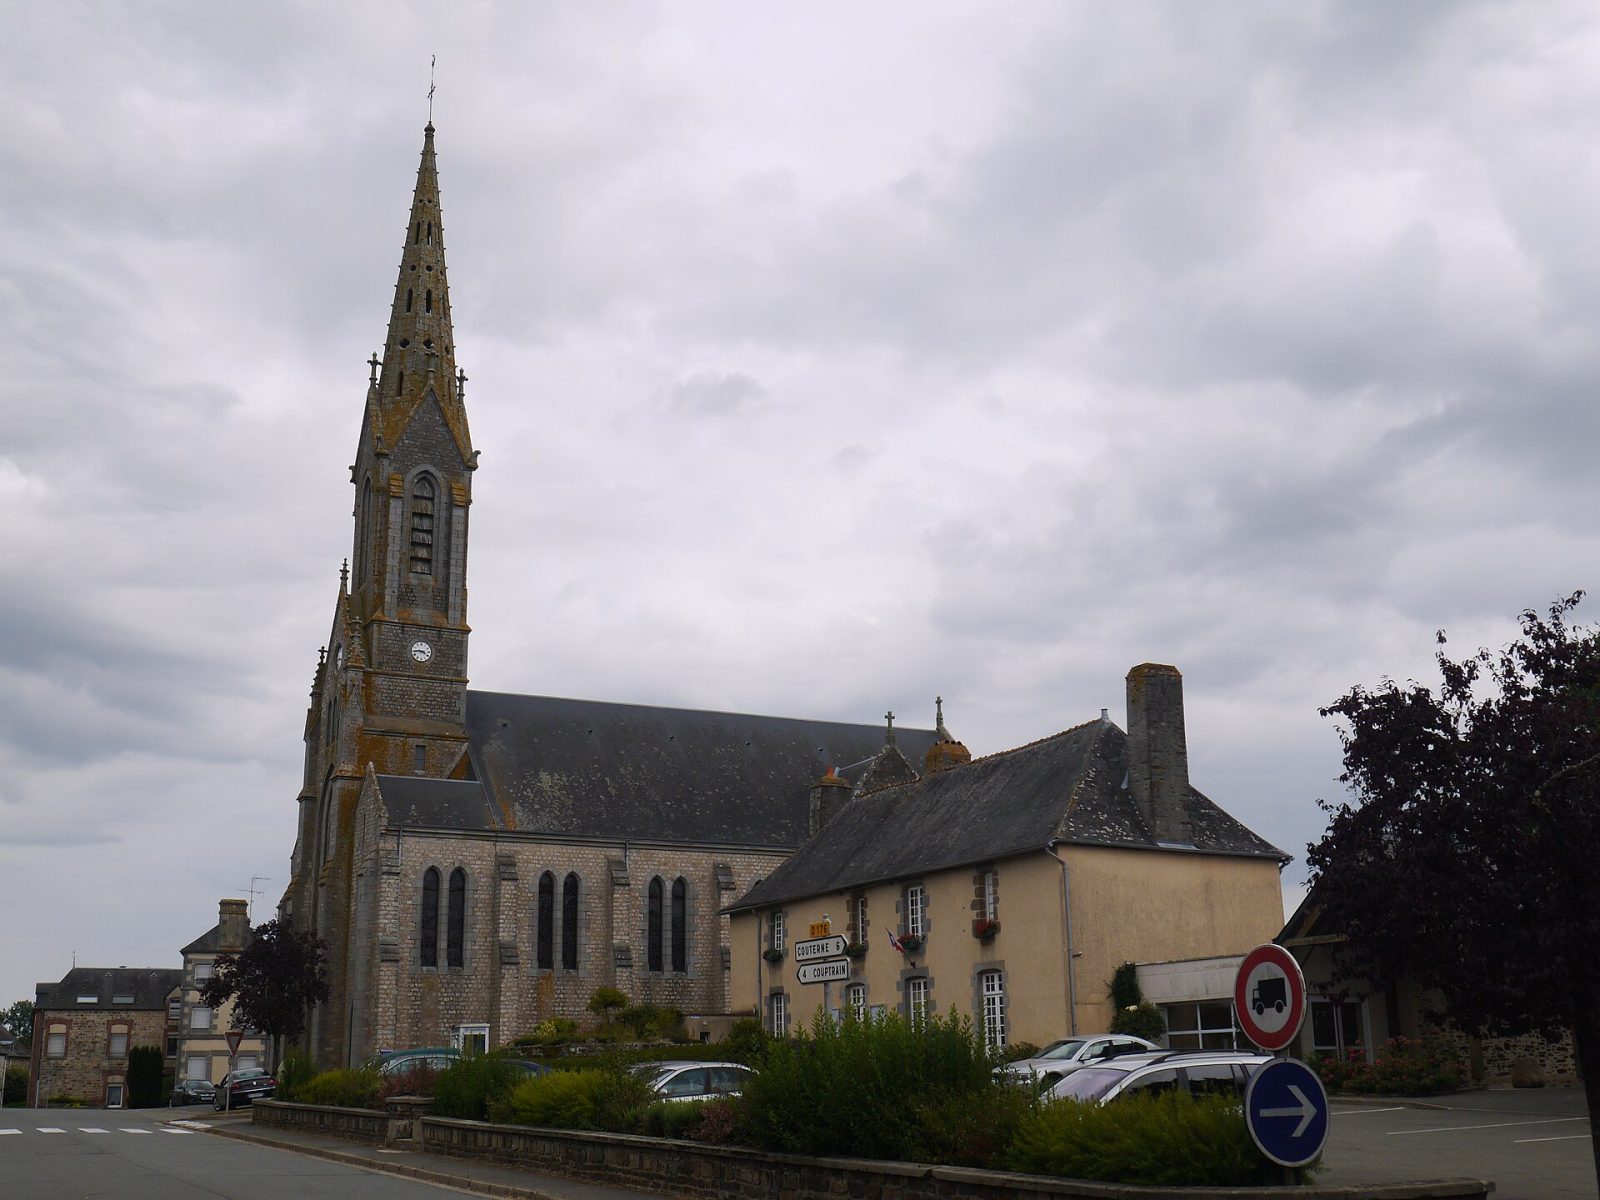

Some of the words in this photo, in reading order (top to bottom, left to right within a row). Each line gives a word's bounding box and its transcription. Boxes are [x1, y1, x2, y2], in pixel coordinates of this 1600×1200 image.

[797, 942, 829, 957] COUTERNE
[836, 941, 841, 951] 6
[802, 969, 807, 979] 4
[813, 964, 846, 978] COUPTRAIN
